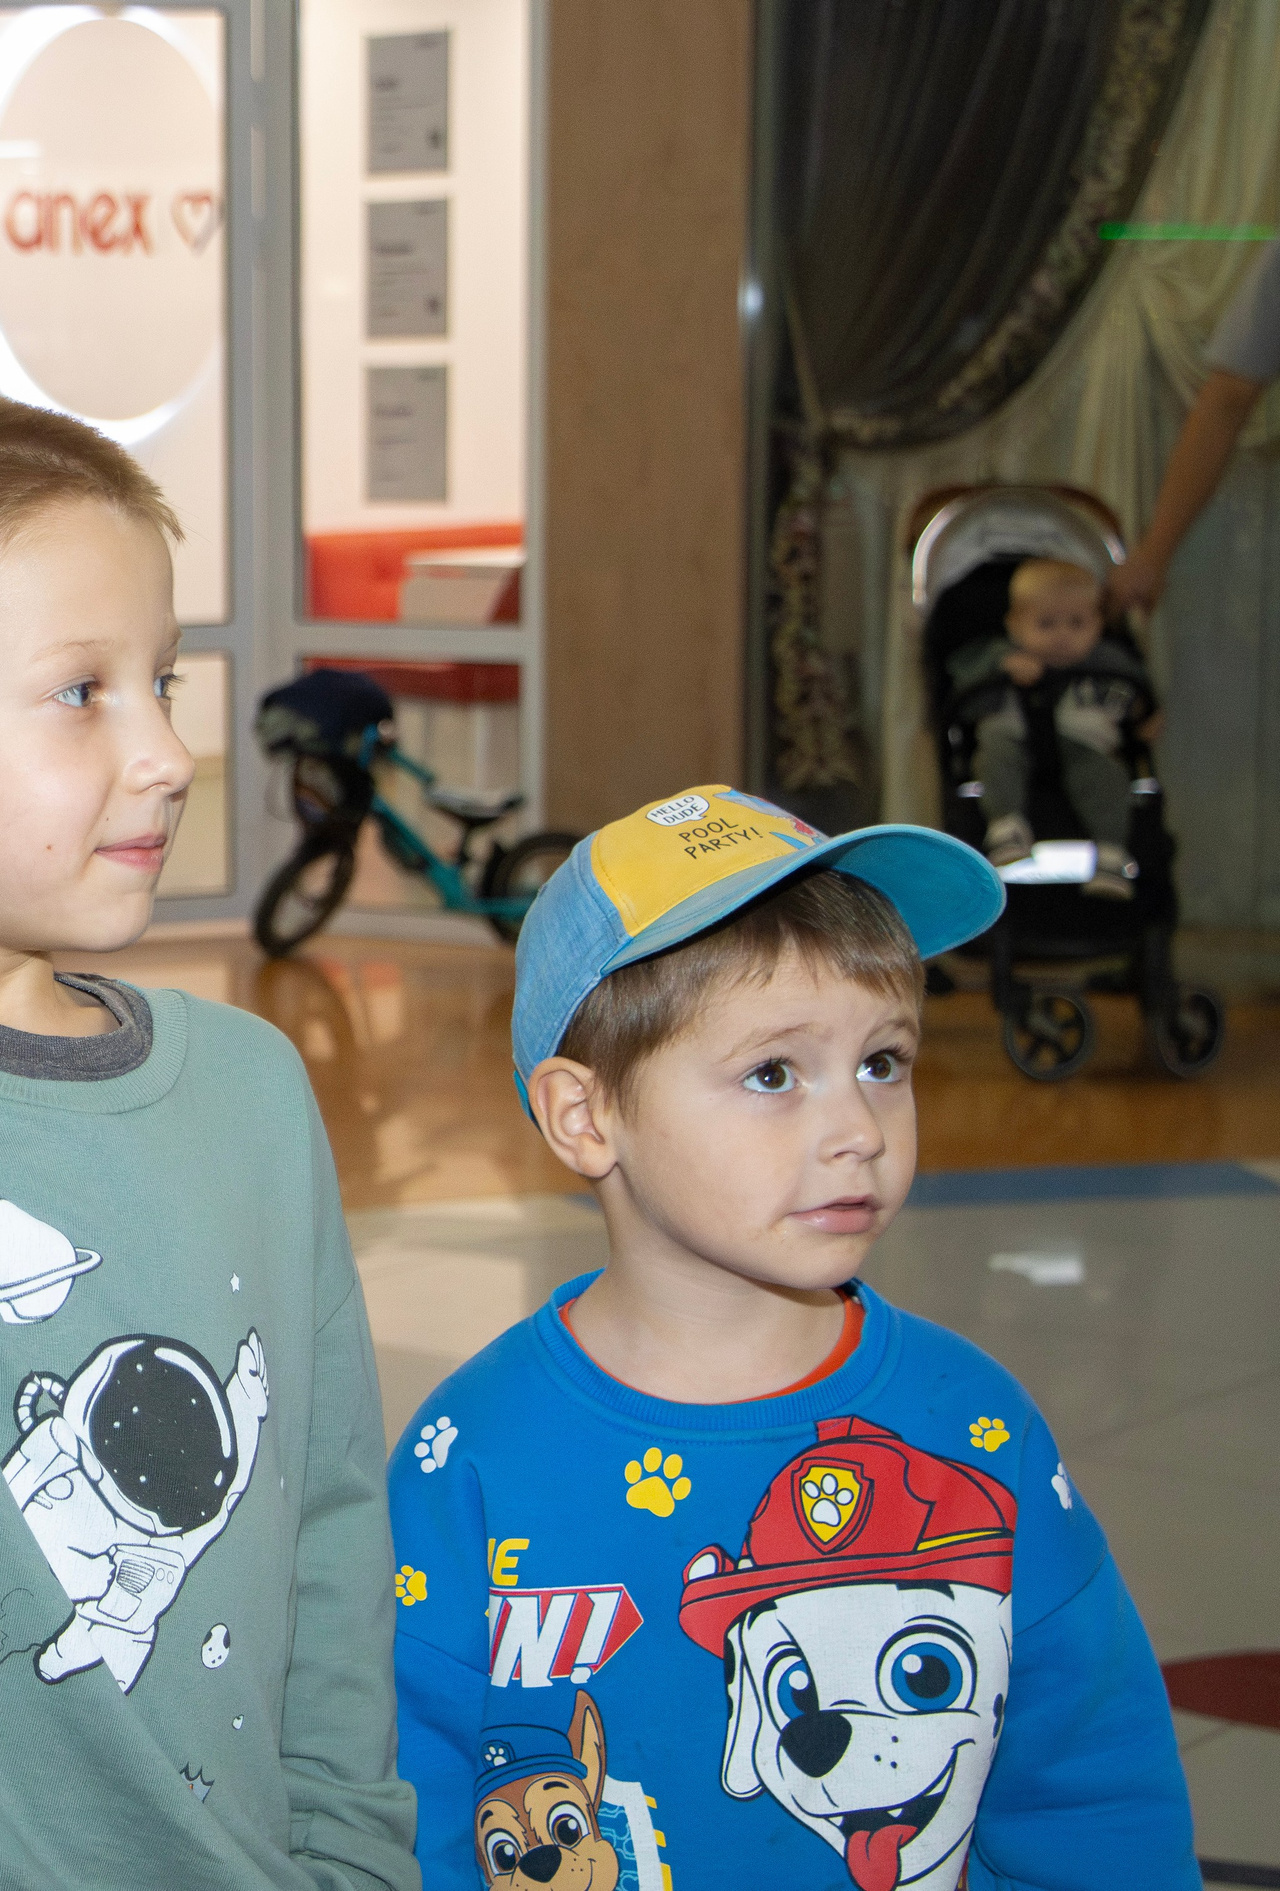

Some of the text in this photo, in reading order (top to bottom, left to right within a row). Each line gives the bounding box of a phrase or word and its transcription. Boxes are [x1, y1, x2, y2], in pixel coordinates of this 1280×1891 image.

[4, 191, 154, 256] anex
[650, 796, 695, 818] HELLO
[662, 802, 703, 824] DUDE
[678, 818, 739, 842] POOL
[684, 827, 763, 859] PARTY!
